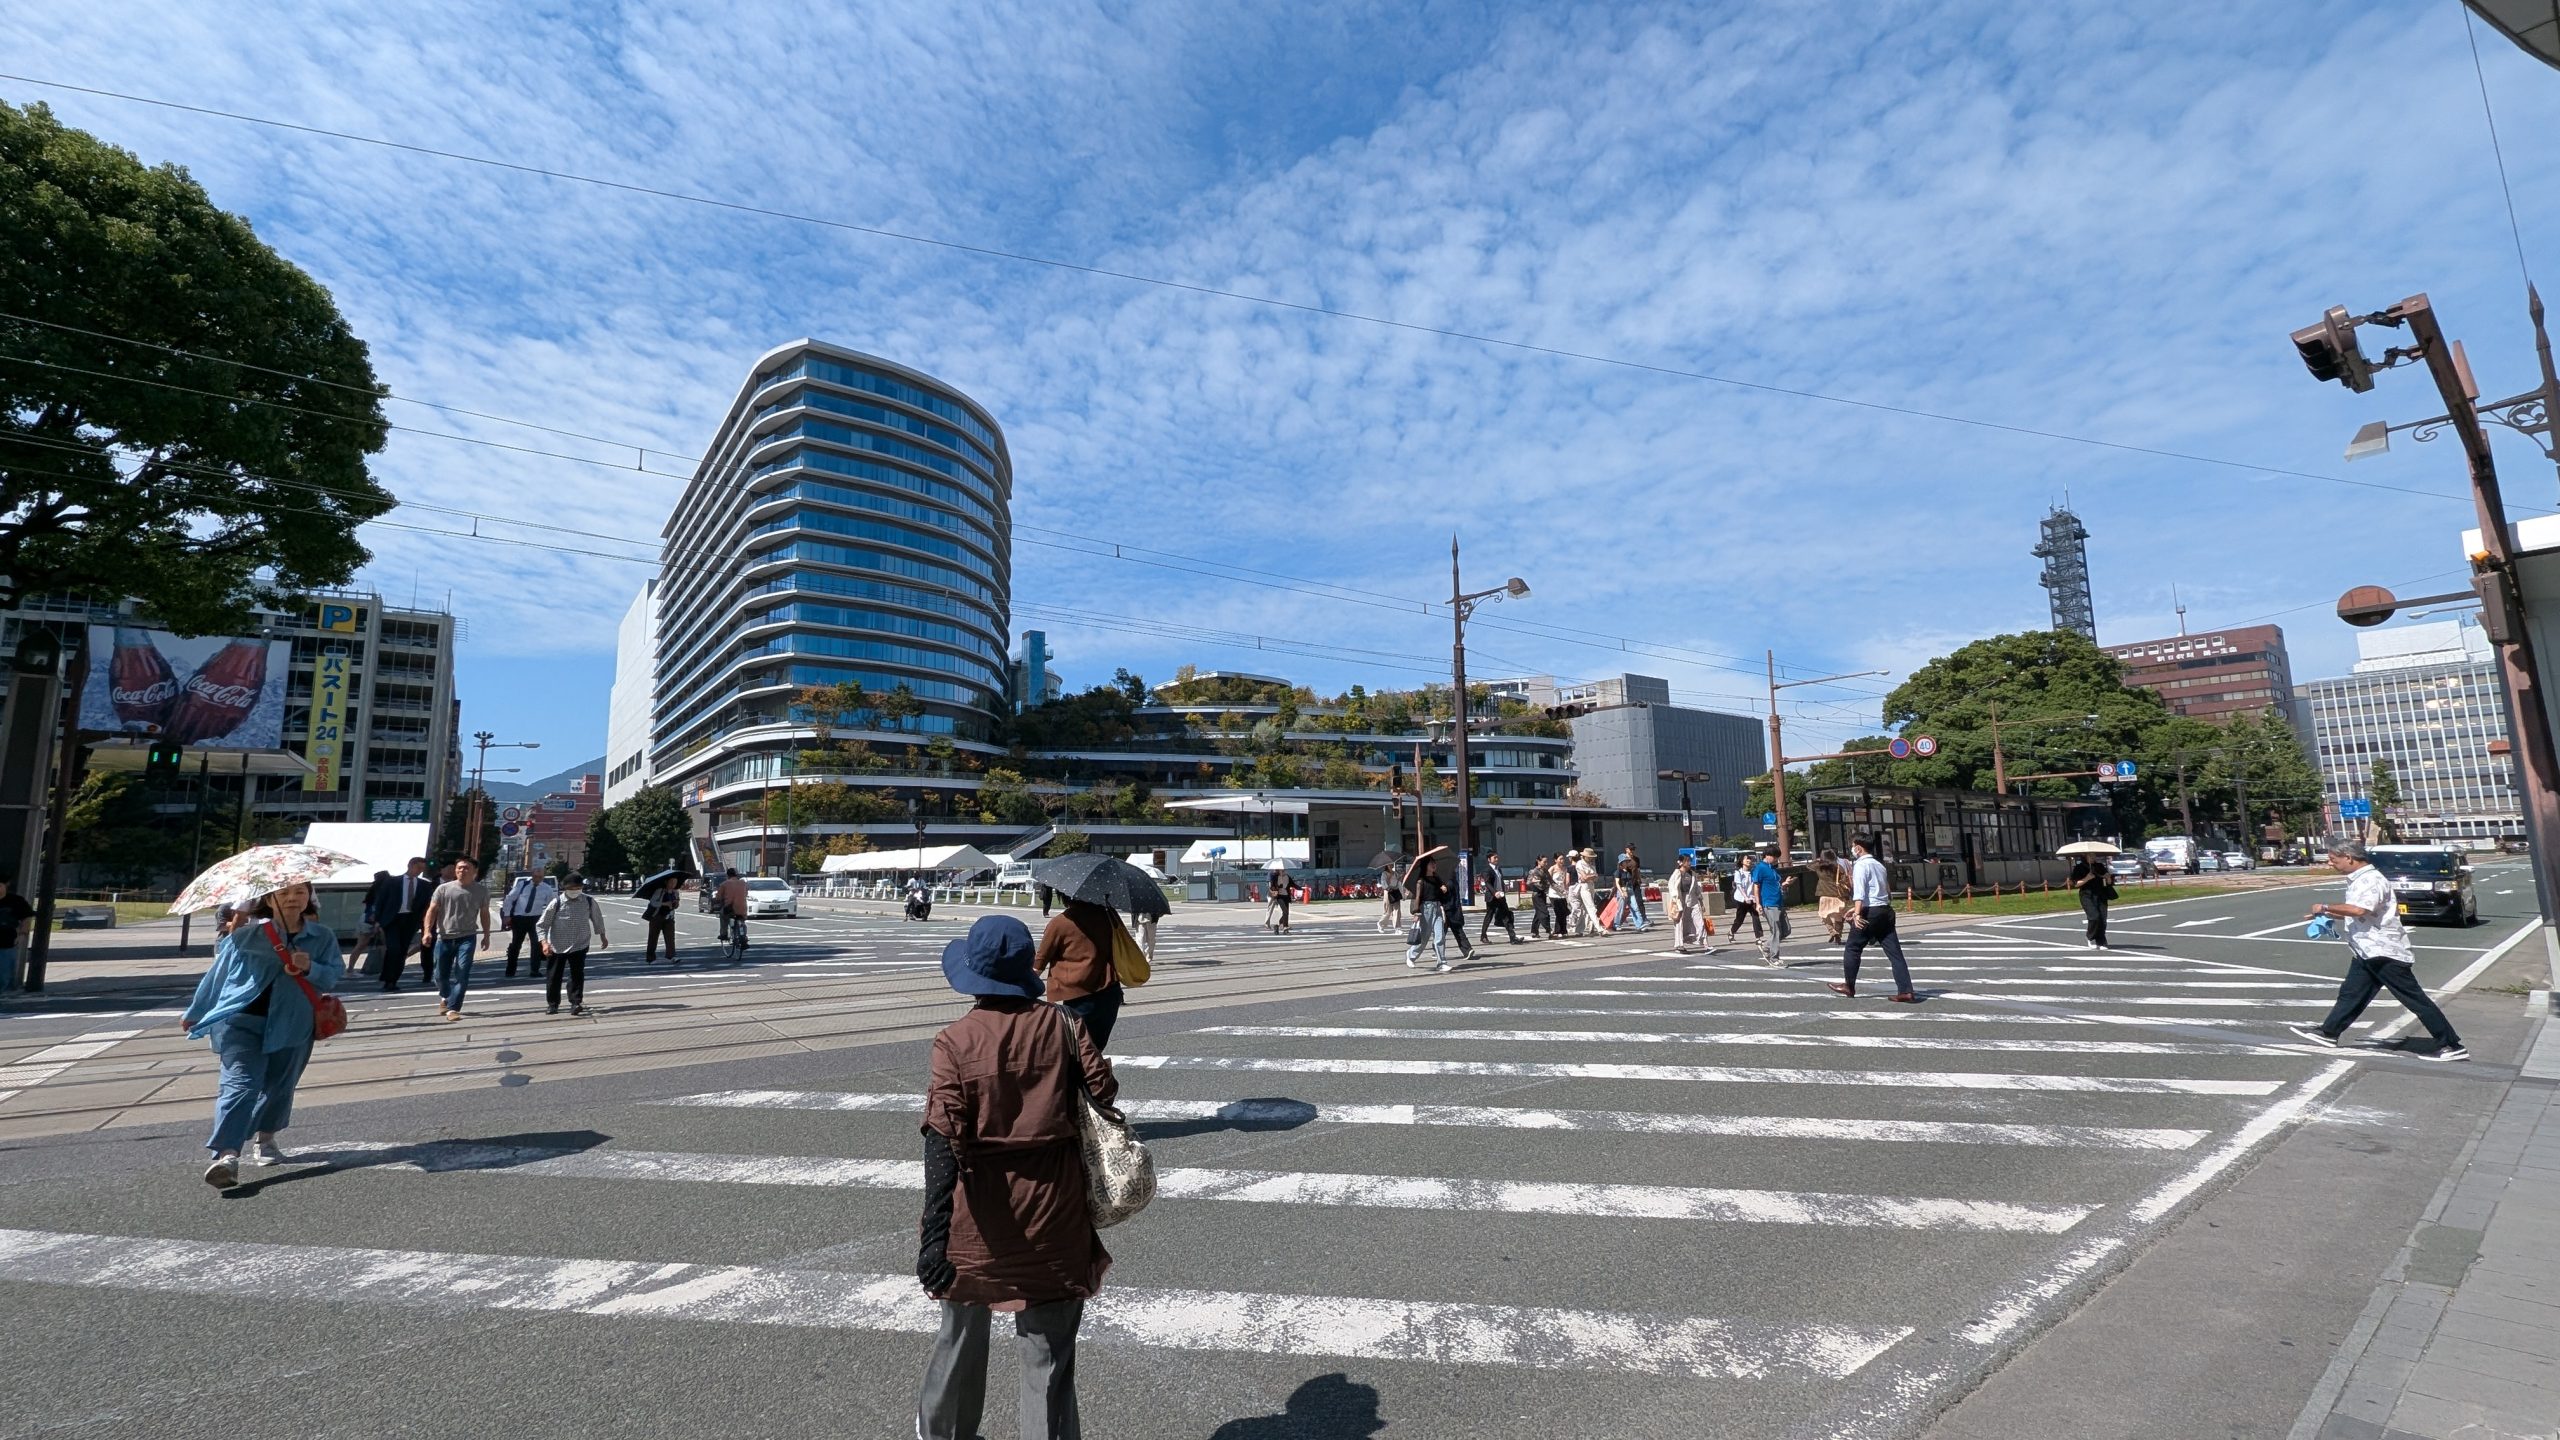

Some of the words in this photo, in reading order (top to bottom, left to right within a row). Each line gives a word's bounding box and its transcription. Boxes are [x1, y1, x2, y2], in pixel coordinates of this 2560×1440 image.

[322, 604, 352, 629] P
[112, 679, 175, 707] Coca-Cola
[186, 674, 256, 708] Coca-Cola
[1920, 741, 1930, 749] 40
[371, 800, 424, 815] 業務
